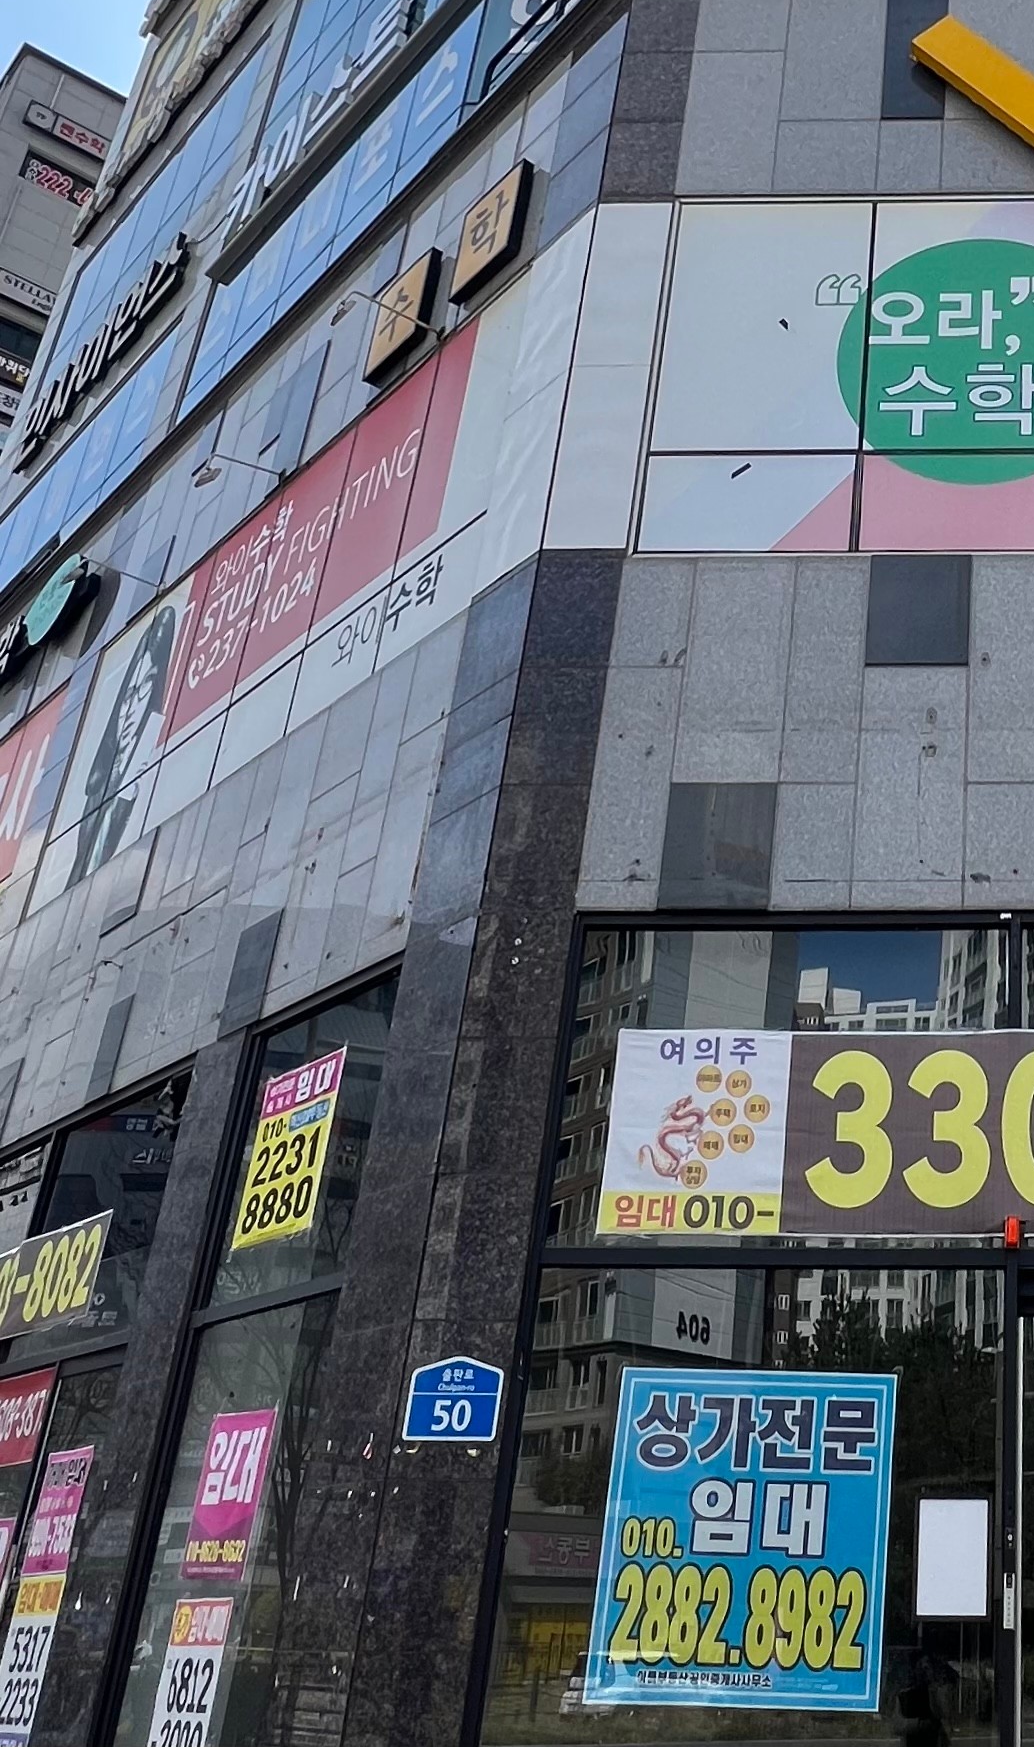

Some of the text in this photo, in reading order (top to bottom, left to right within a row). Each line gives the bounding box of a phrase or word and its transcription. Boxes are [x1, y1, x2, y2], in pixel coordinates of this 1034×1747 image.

[4, 274, 57, 305] STELLA
[197, 428, 421, 647] STUDY FIGHTING
[211, 499, 294, 595] 와이수학
[202, 556, 318, 680] 237-1024
[331, 554, 444, 667] 와이수학
[295, 1058, 337, 1104] 임대
[659, 1036, 758, 1067] 여의주
[251, 1125, 321, 1189] 2231
[241, 1175, 313, 1235] 8880
[614, 1194, 676, 1229] 임대
[683, 1194, 775, 1230] 010-
[430, 1399, 472, 1432] 50
[632, 1392, 879, 1475] 상가전문
[200, 1426, 268, 1507] 임대
[690, 1478, 830, 1559] 임대
[609, 1561, 866, 1672] 2882.8982
[9, 1625, 51, 1674] 5317
[166, 1657, 215, 1715] 6812
